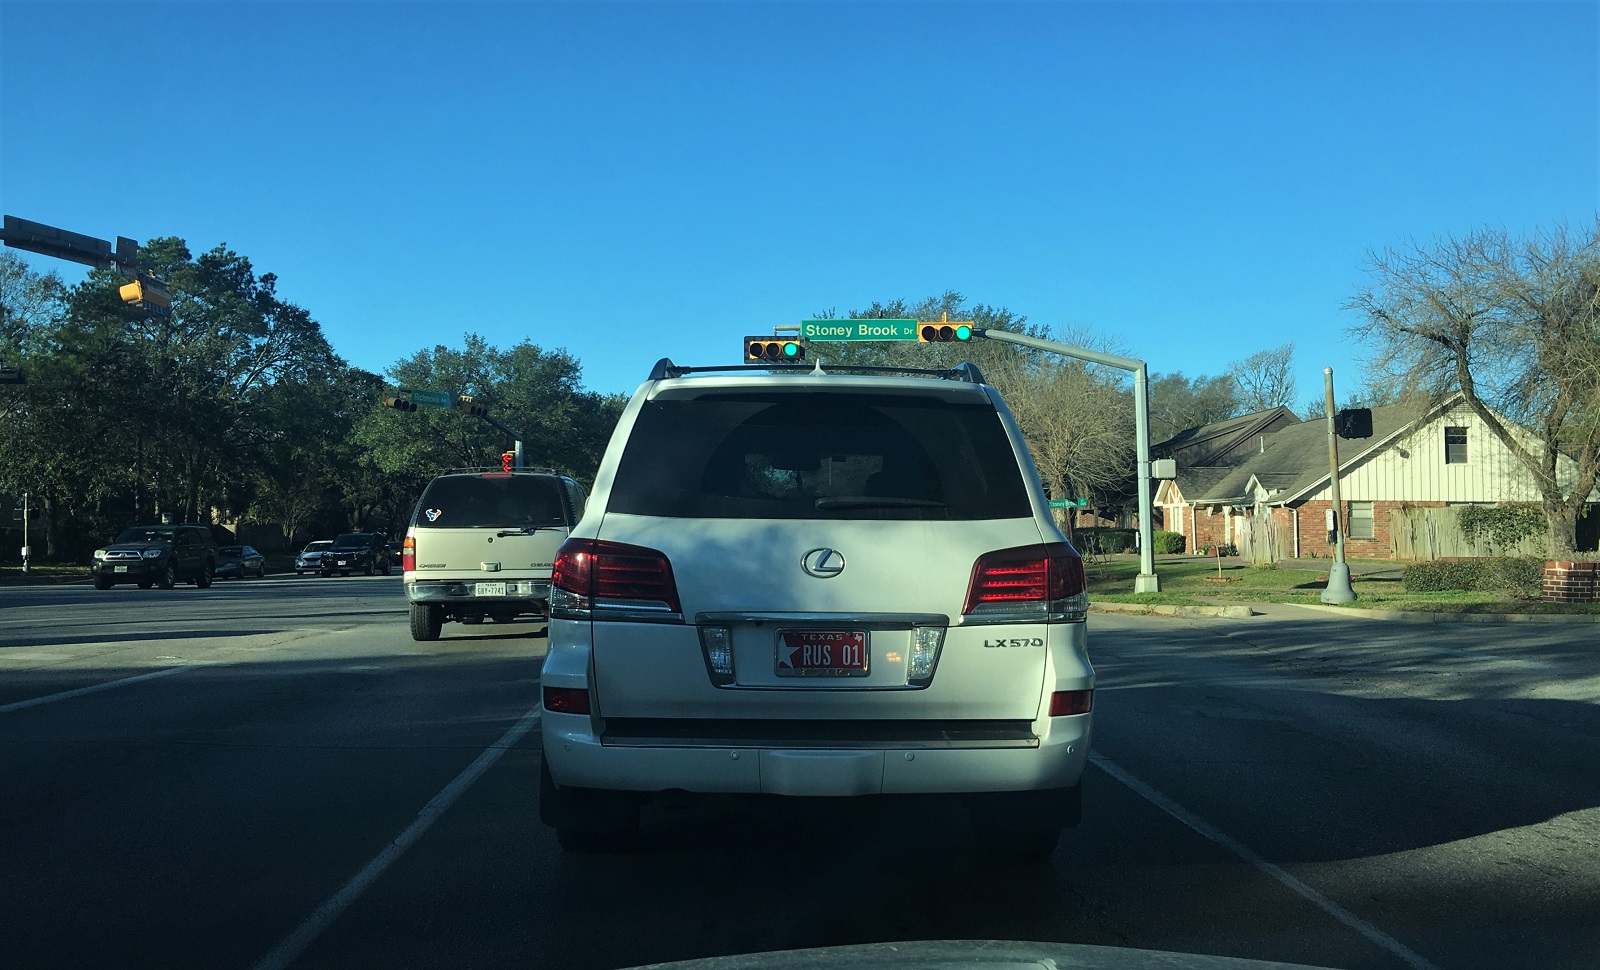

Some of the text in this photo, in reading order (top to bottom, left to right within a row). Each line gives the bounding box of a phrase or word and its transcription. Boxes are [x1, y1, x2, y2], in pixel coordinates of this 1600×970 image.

[806, 324, 913, 338] Stoney Brook Dr
[801, 633, 843, 641] TEXAS
[803, 644, 861, 666] RUS 01
